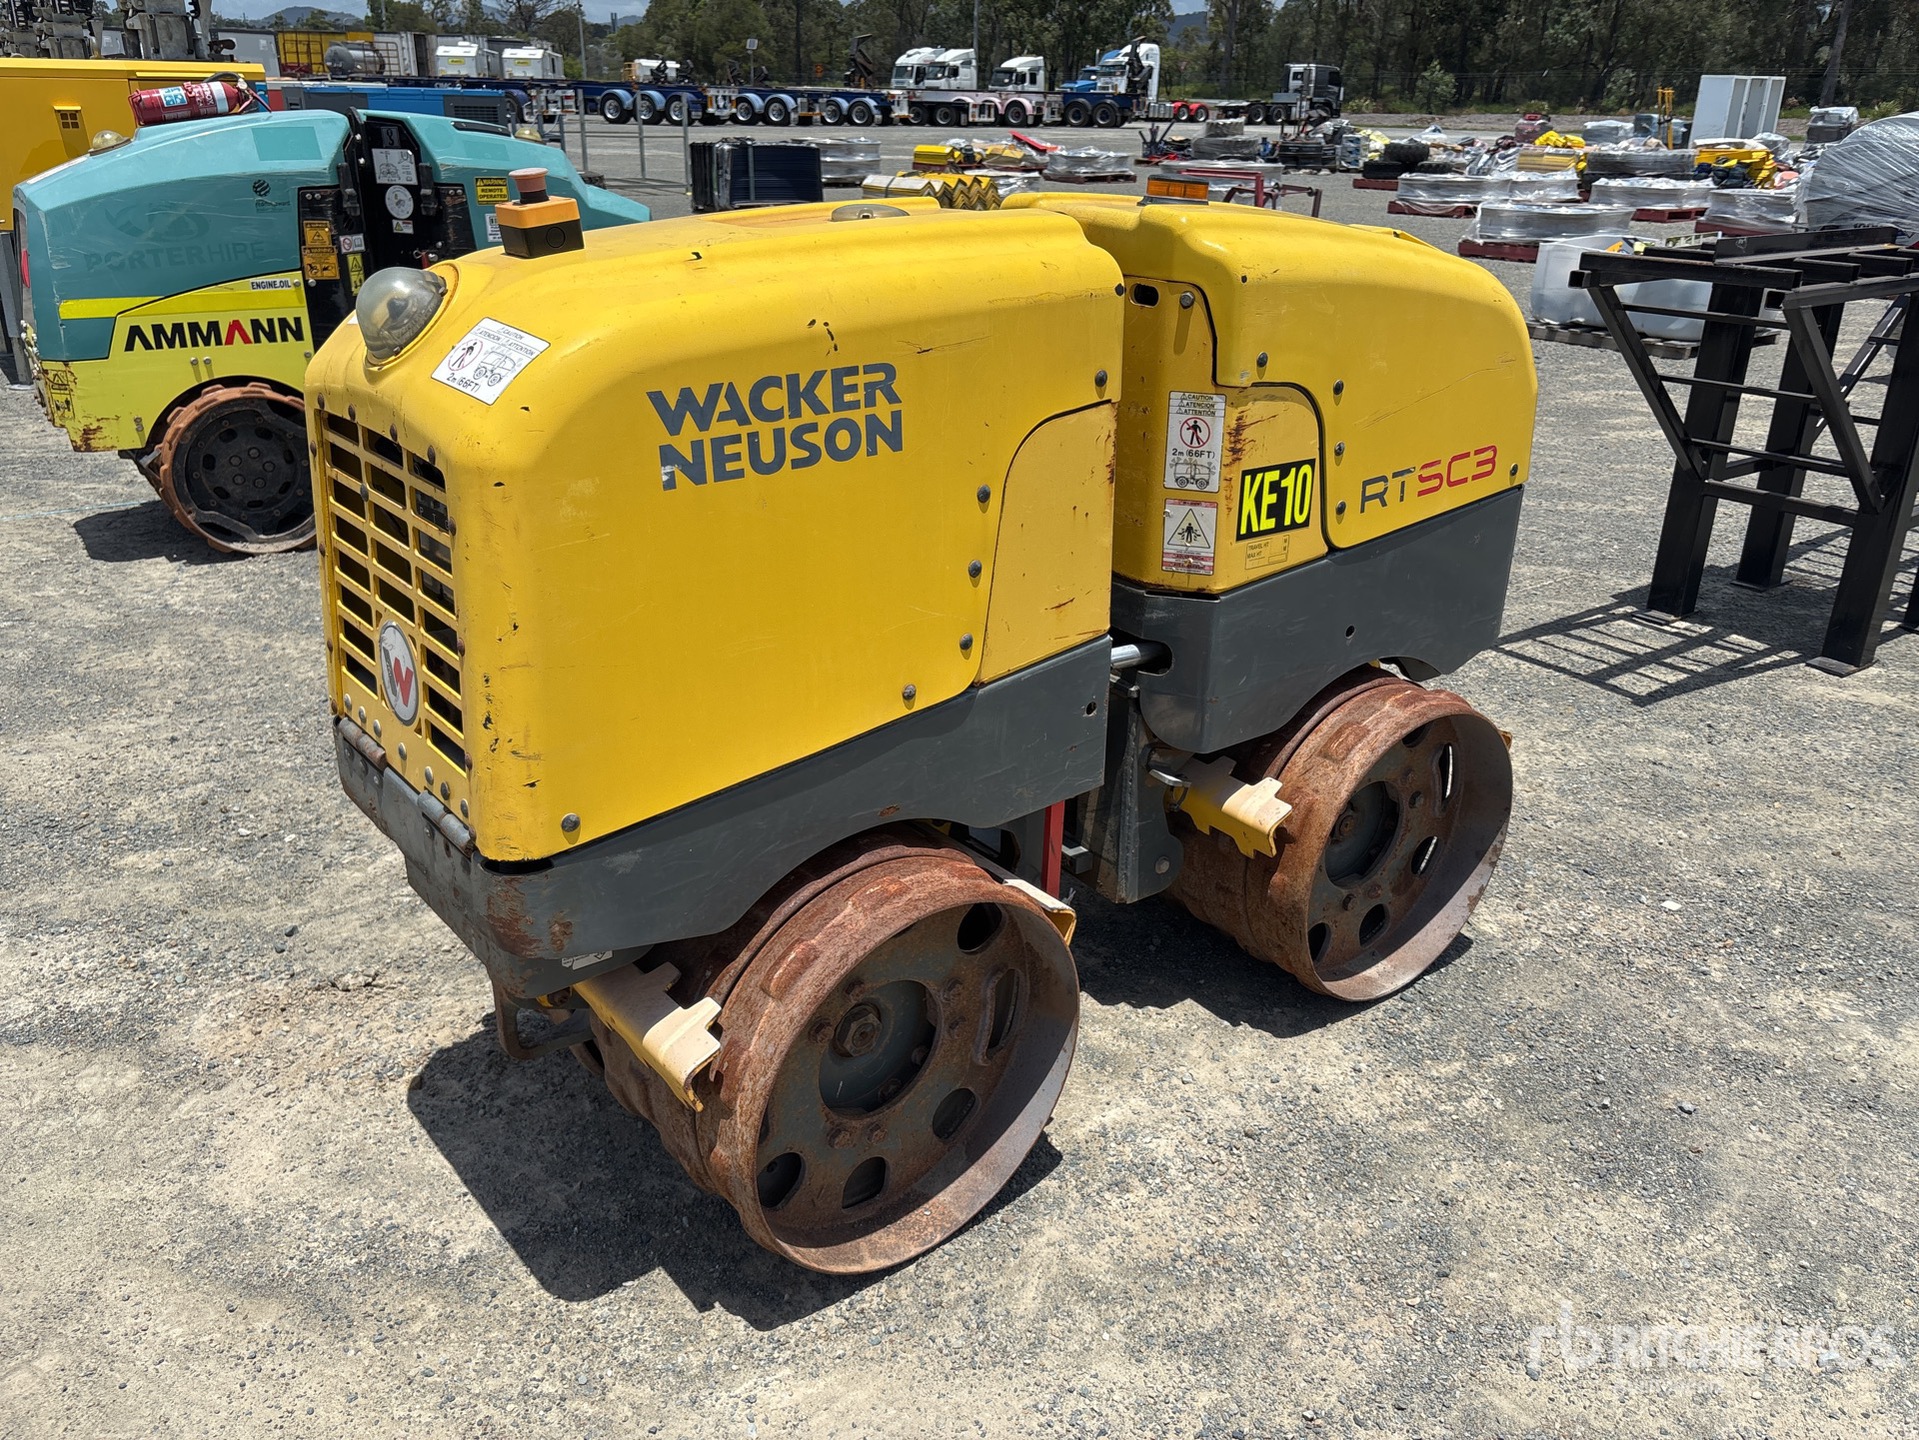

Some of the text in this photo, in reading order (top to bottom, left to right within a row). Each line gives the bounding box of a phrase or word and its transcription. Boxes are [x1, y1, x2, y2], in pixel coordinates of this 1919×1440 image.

[125, 317, 304, 352] AMMANN
[502, 328, 525, 340] CAUTION
[646, 362, 902, 436] WACKER
[1183, 408, 1216, 416] ATTENTION
[658, 409, 903, 491] NEUSON
[1172, 448, 1185, 457] 2m
